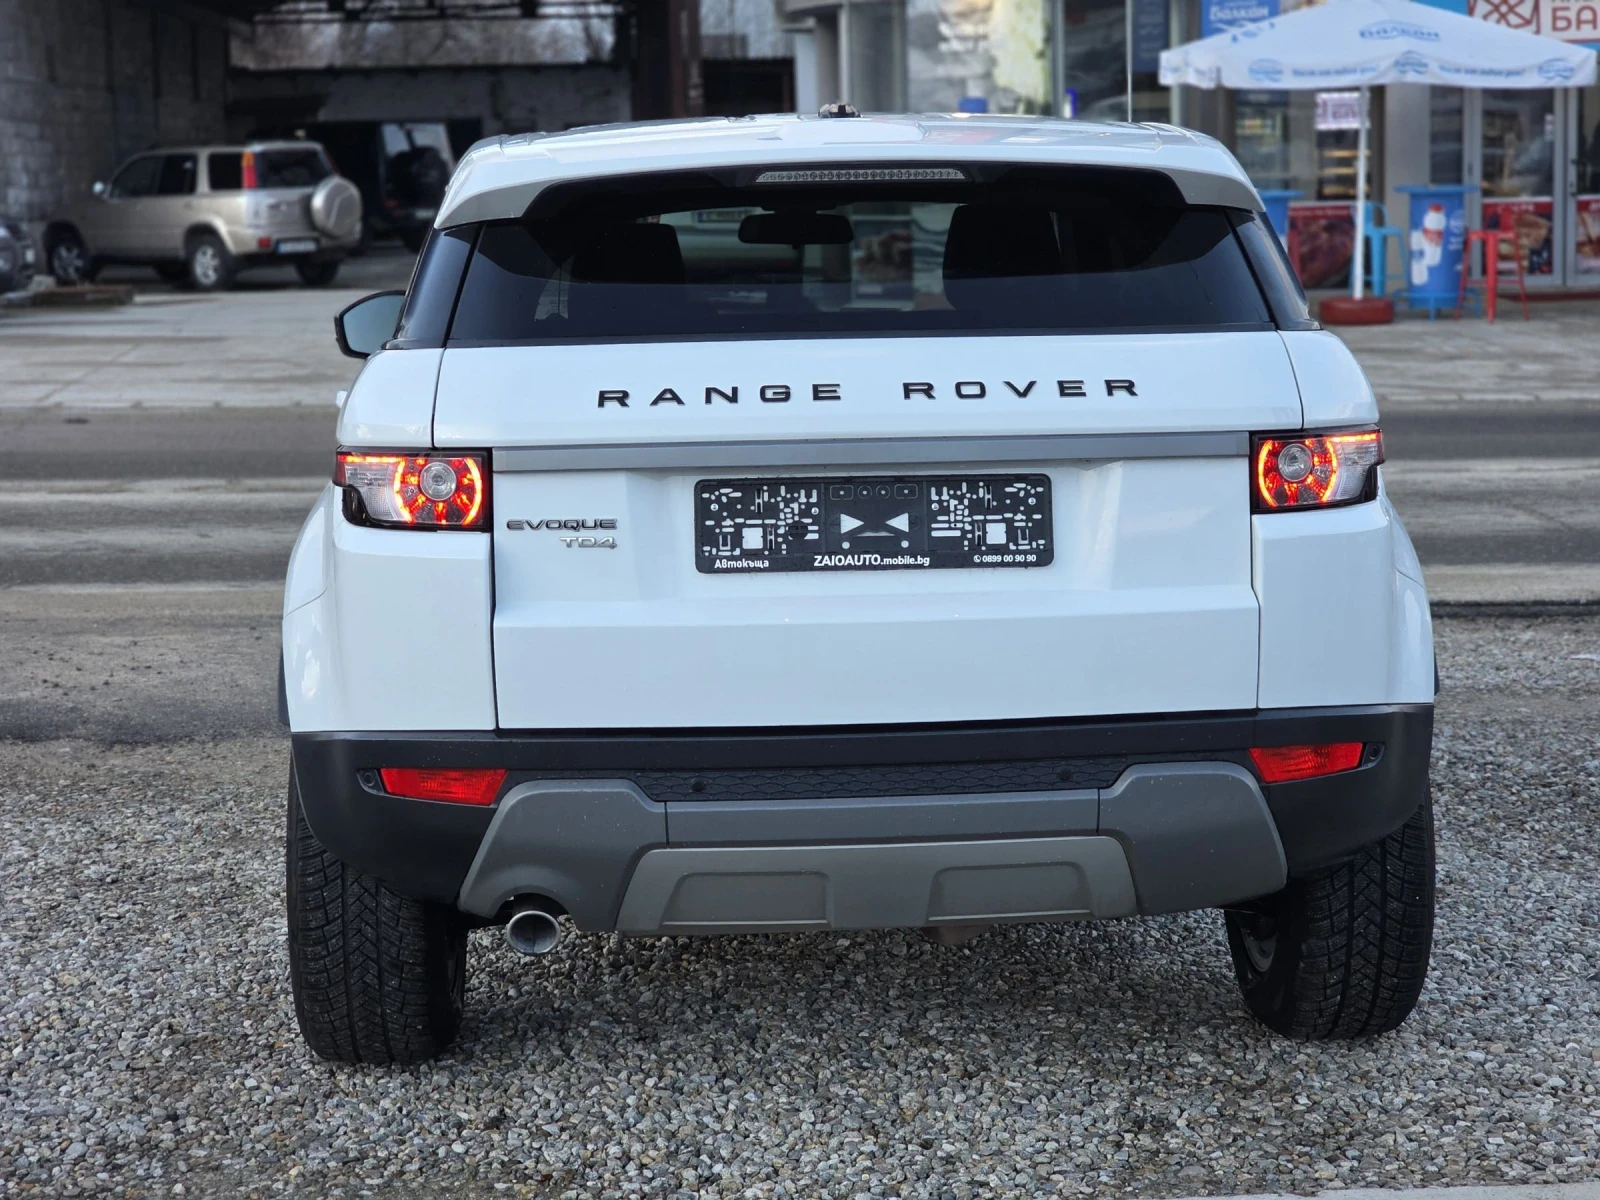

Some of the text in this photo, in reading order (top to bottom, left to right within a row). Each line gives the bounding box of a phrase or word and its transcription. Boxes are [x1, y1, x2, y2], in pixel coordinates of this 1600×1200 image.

[597, 379, 1139, 409] RANGE ROVER
[506, 519, 618, 532] EVOQUE
[560, 537, 617, 549] TD4
[714, 558, 769, 569] Автокъща
[813, 553, 931, 567] ZAIOAUTO.mobile.bg
[982, 554, 1037, 563] 0899 00 90 90
